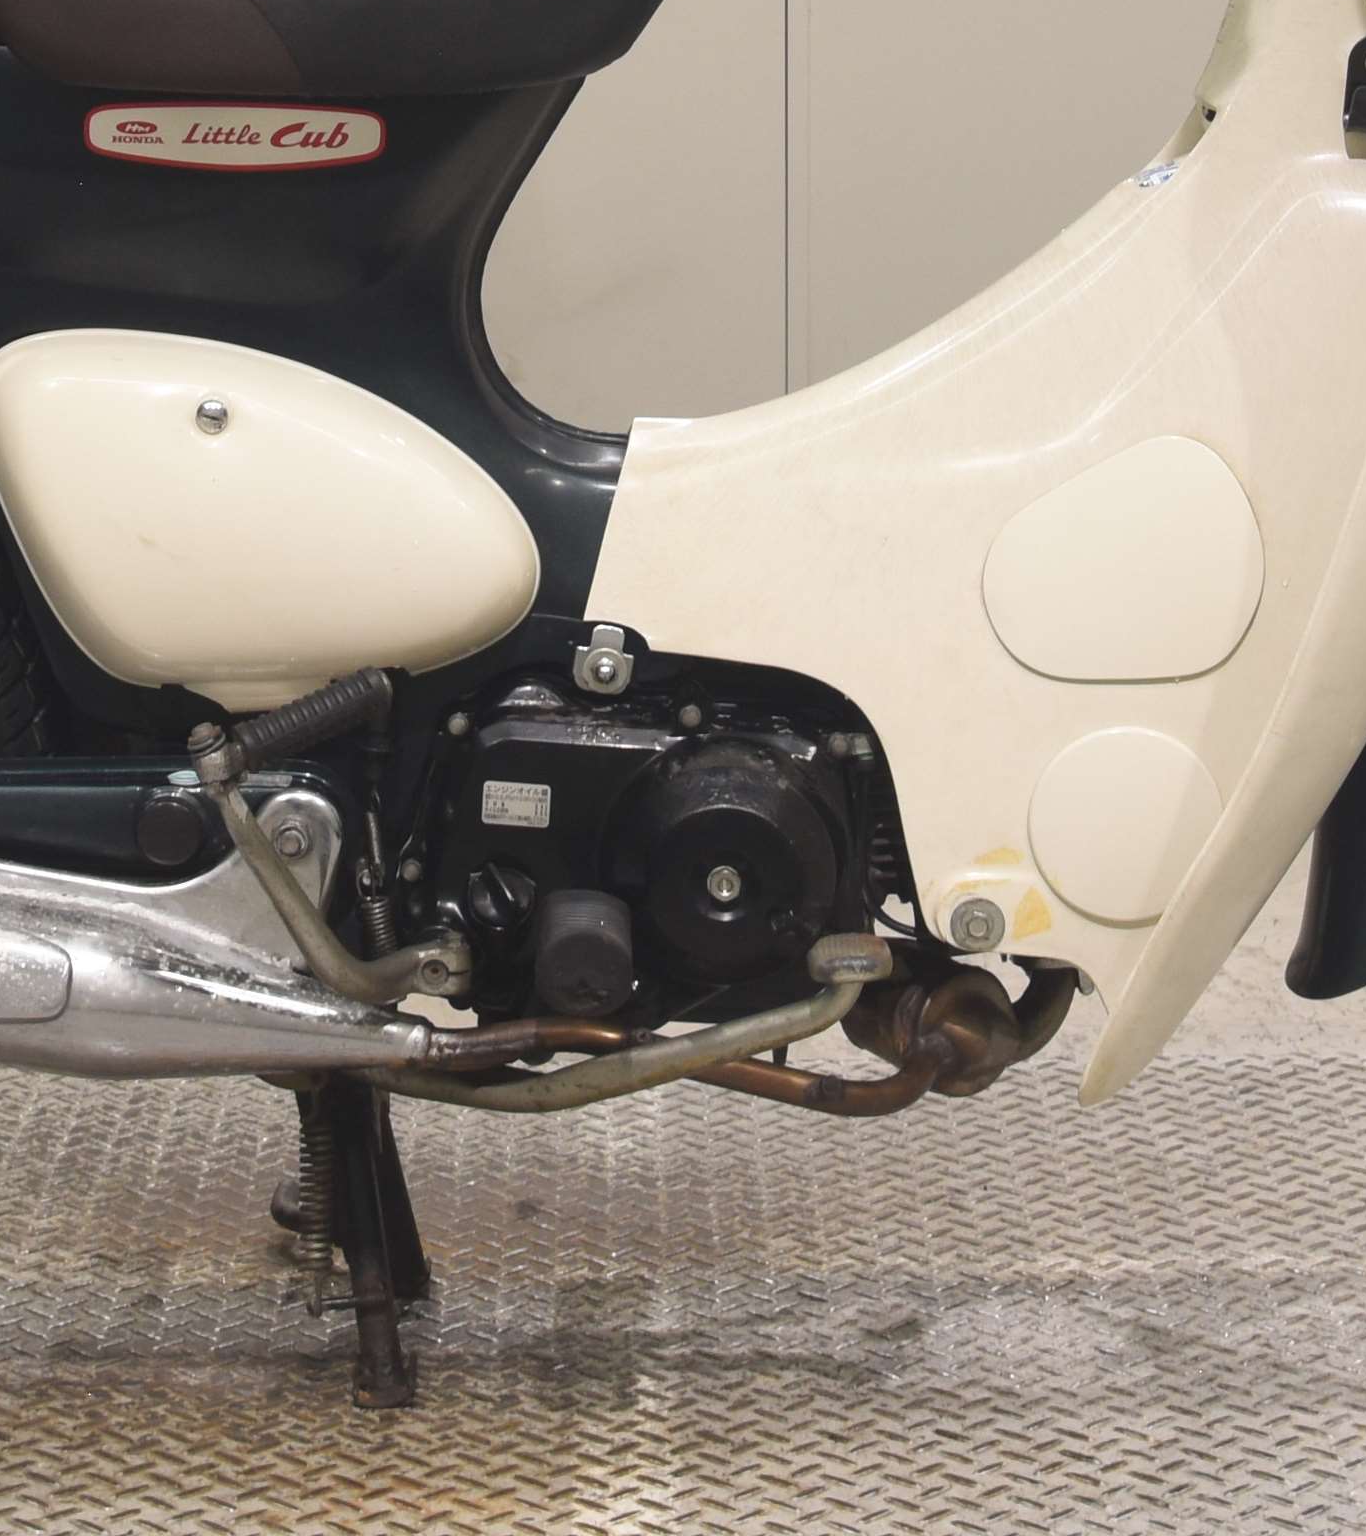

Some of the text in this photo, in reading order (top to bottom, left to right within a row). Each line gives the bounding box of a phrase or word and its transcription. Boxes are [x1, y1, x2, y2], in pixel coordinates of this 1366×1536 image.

[112, 135, 164, 144] HONDA
[182, 121, 350, 149] Little Cub
